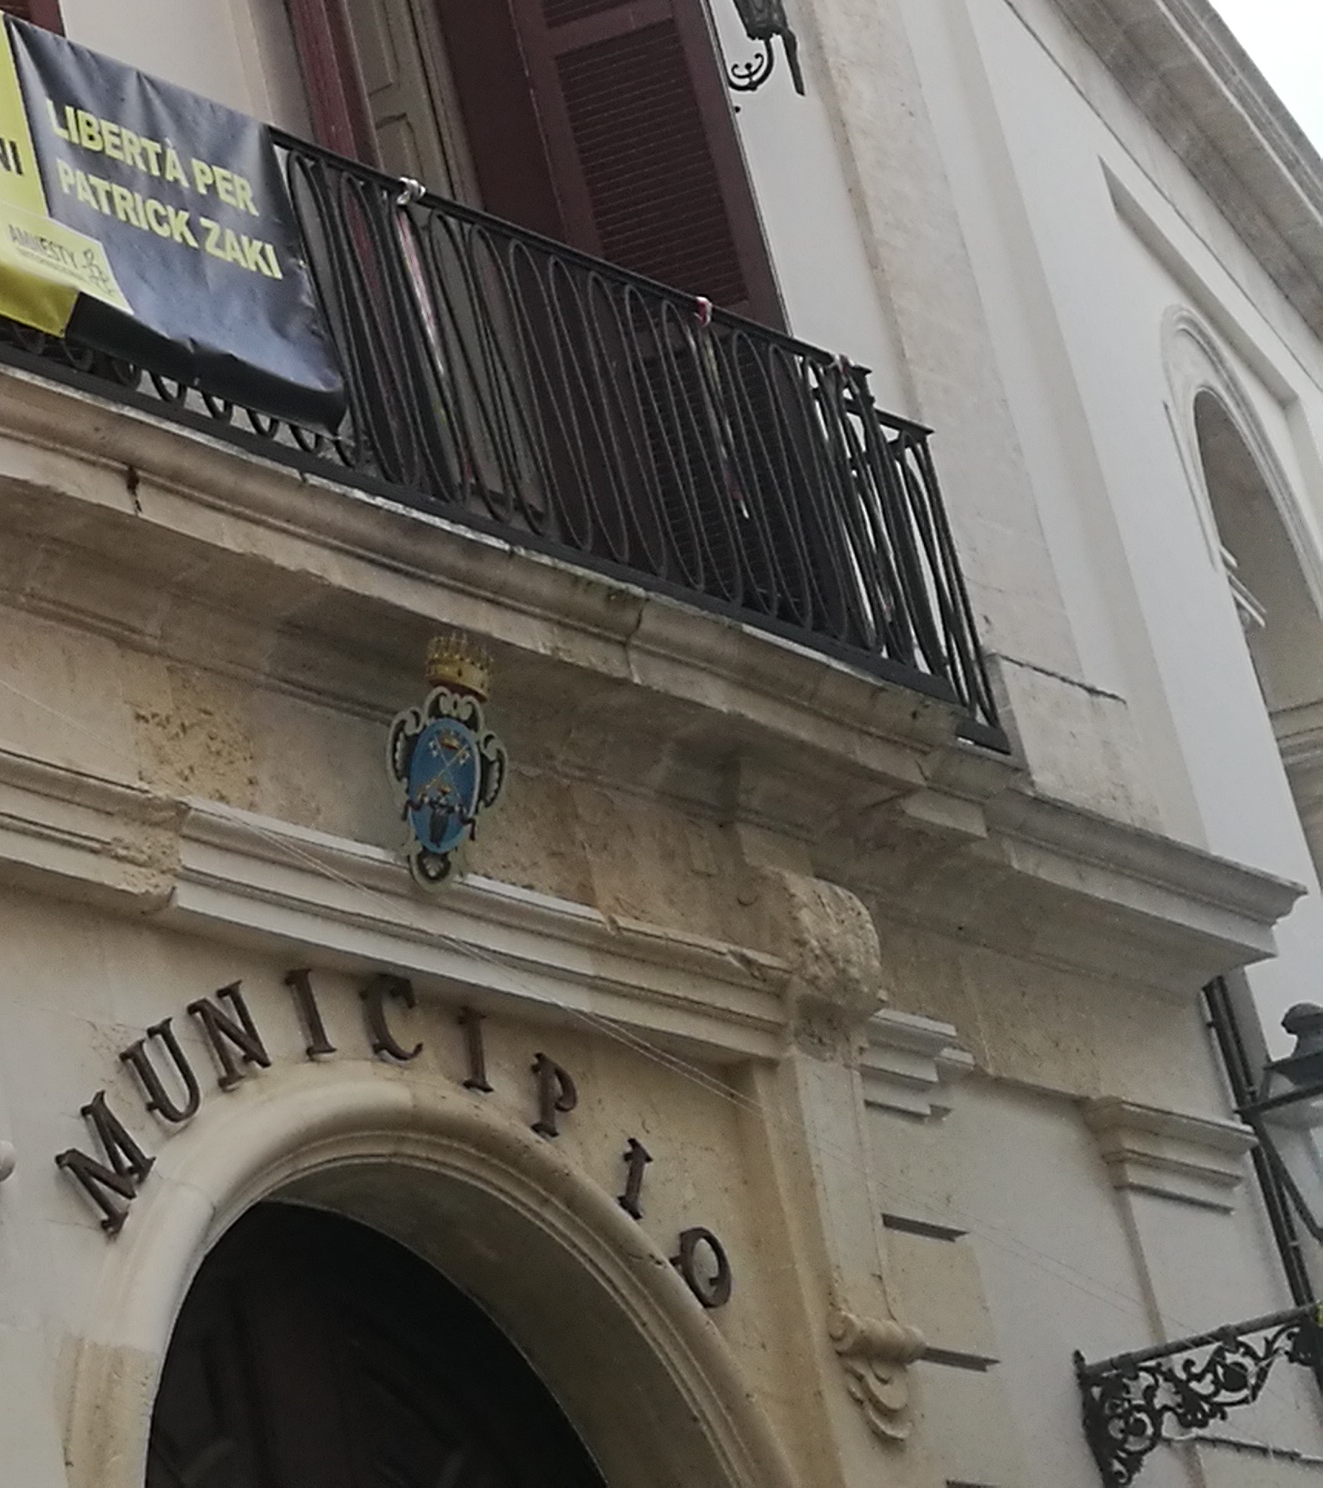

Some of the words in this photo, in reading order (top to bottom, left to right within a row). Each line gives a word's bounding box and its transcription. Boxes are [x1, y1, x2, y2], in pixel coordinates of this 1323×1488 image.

[46, 97, 189, 188] LIBERTÀ
[191, 158, 259, 216] PER
[57, 158, 199, 248] PATRICK
[200, 217, 283, 279] ZAKI
[55, 968, 733, 1309] MUNICIPIO
